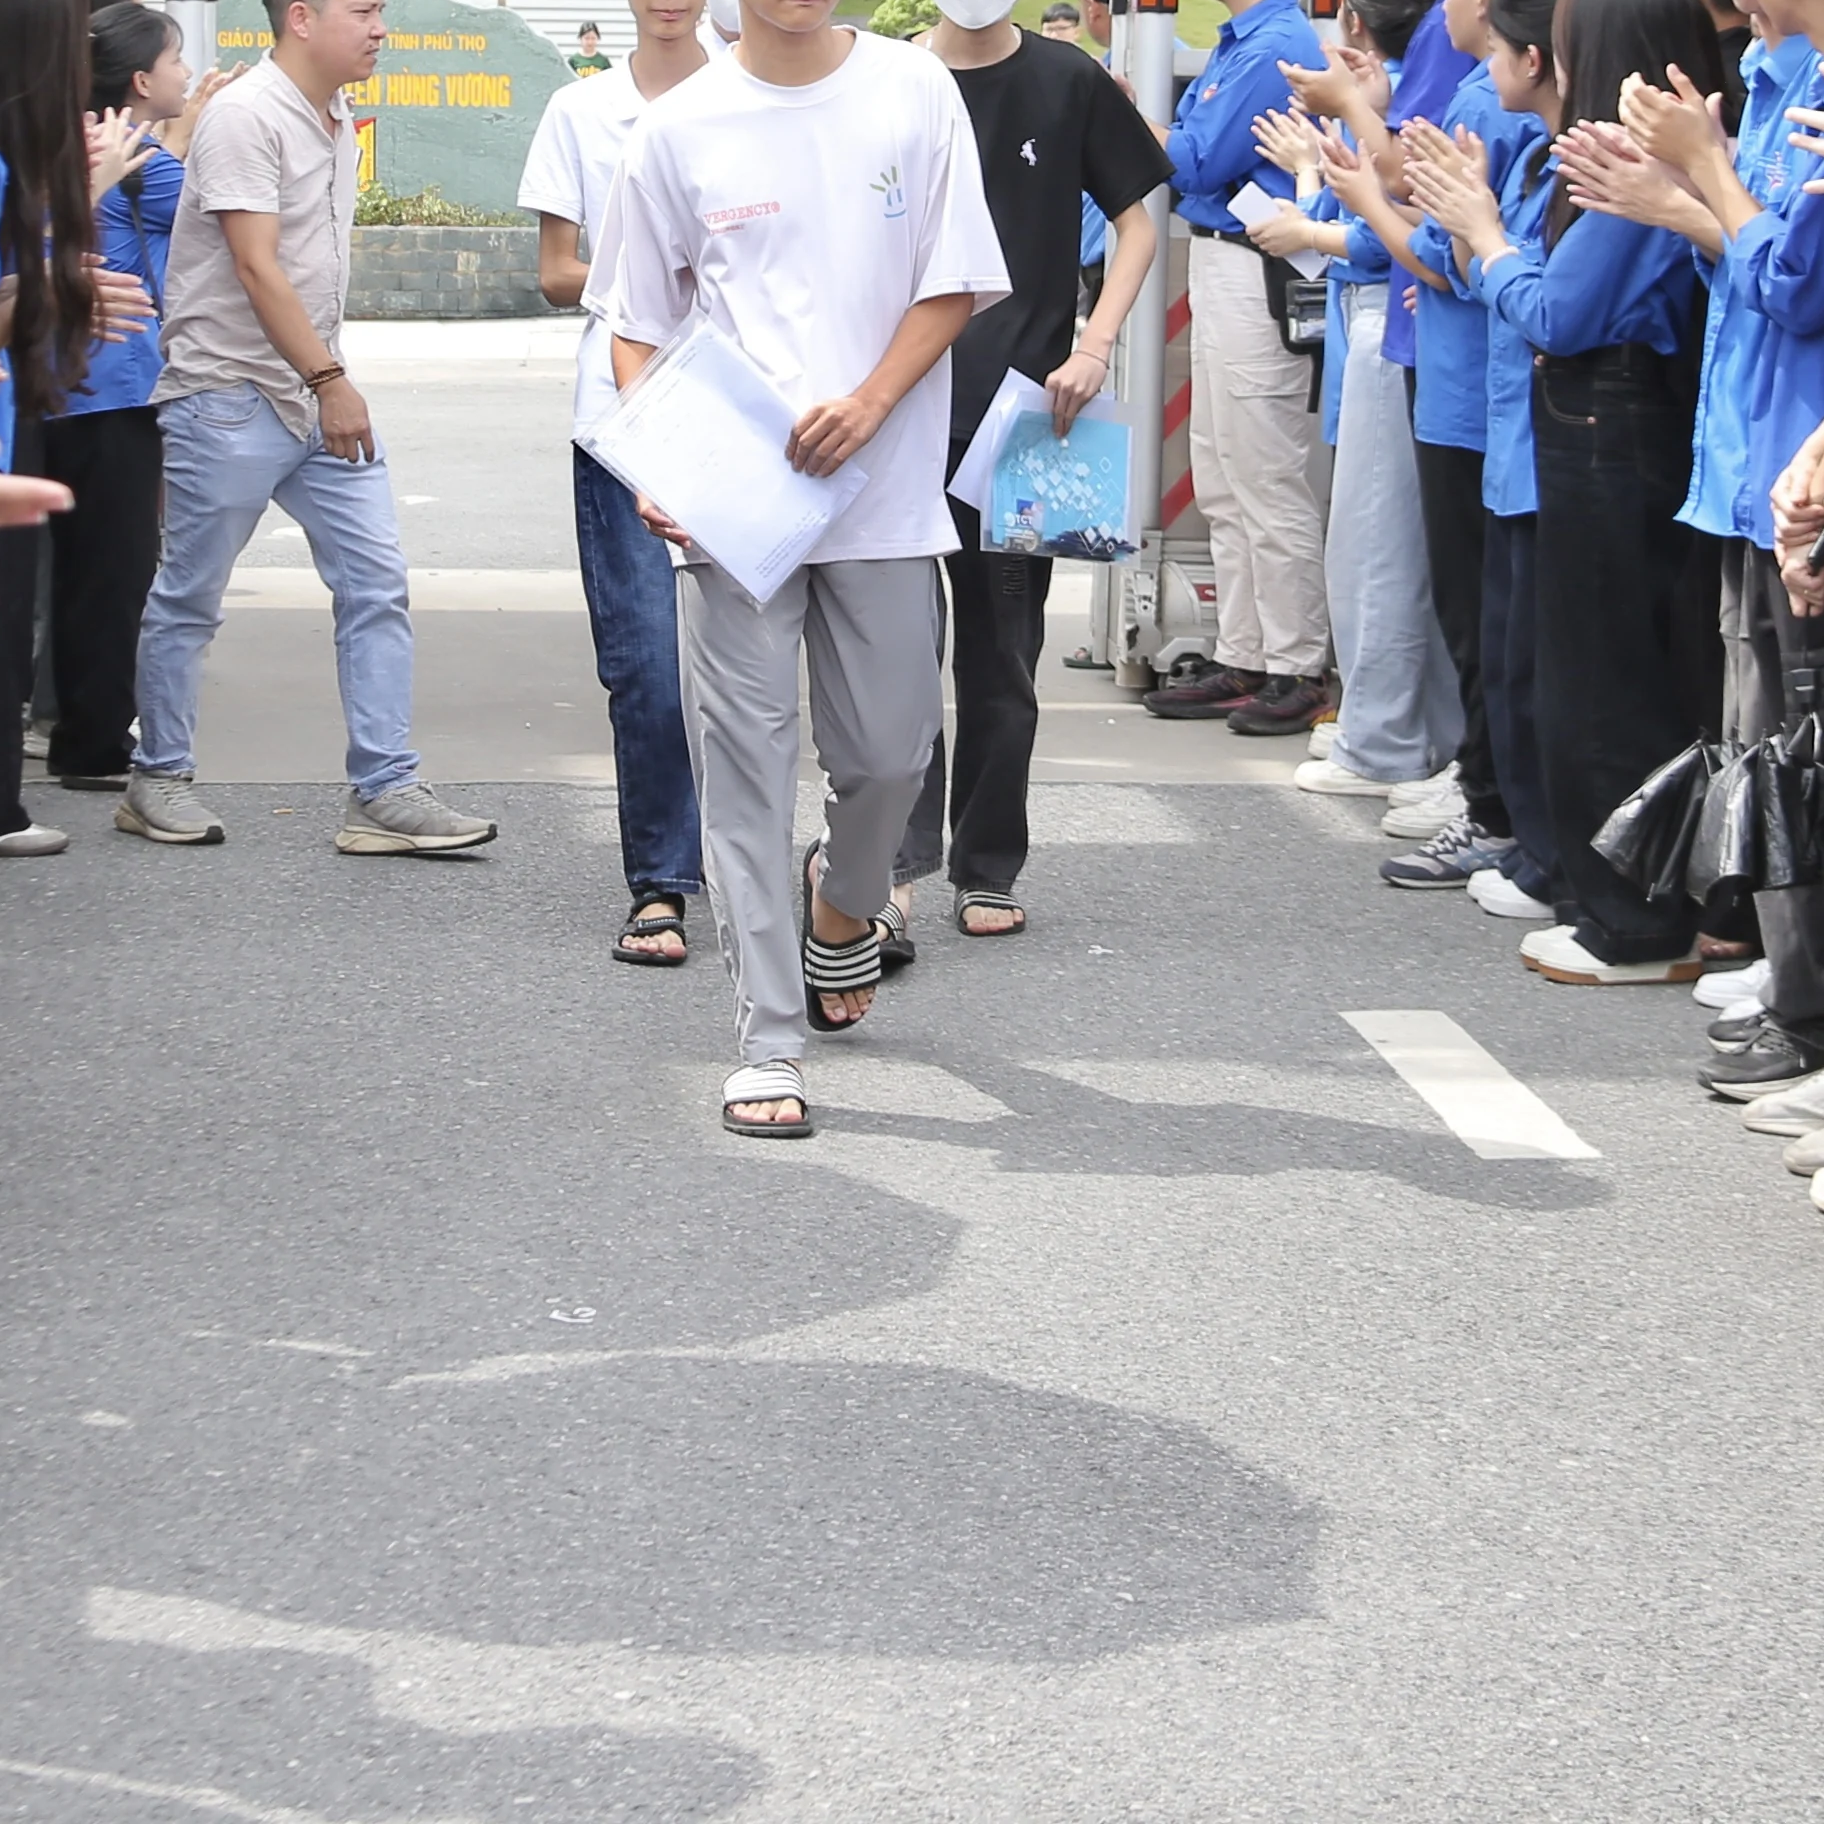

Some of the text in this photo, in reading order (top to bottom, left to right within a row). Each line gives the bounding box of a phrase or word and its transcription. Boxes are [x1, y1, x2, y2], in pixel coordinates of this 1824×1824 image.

[217, 26, 254, 48] GIÁO
[423, 30, 453, 51] PHÚ
[456, 33, 487, 58] THỌ
[385, 66, 440, 107] HÙNG
[445, 71, 512, 108] VƯƠNG
